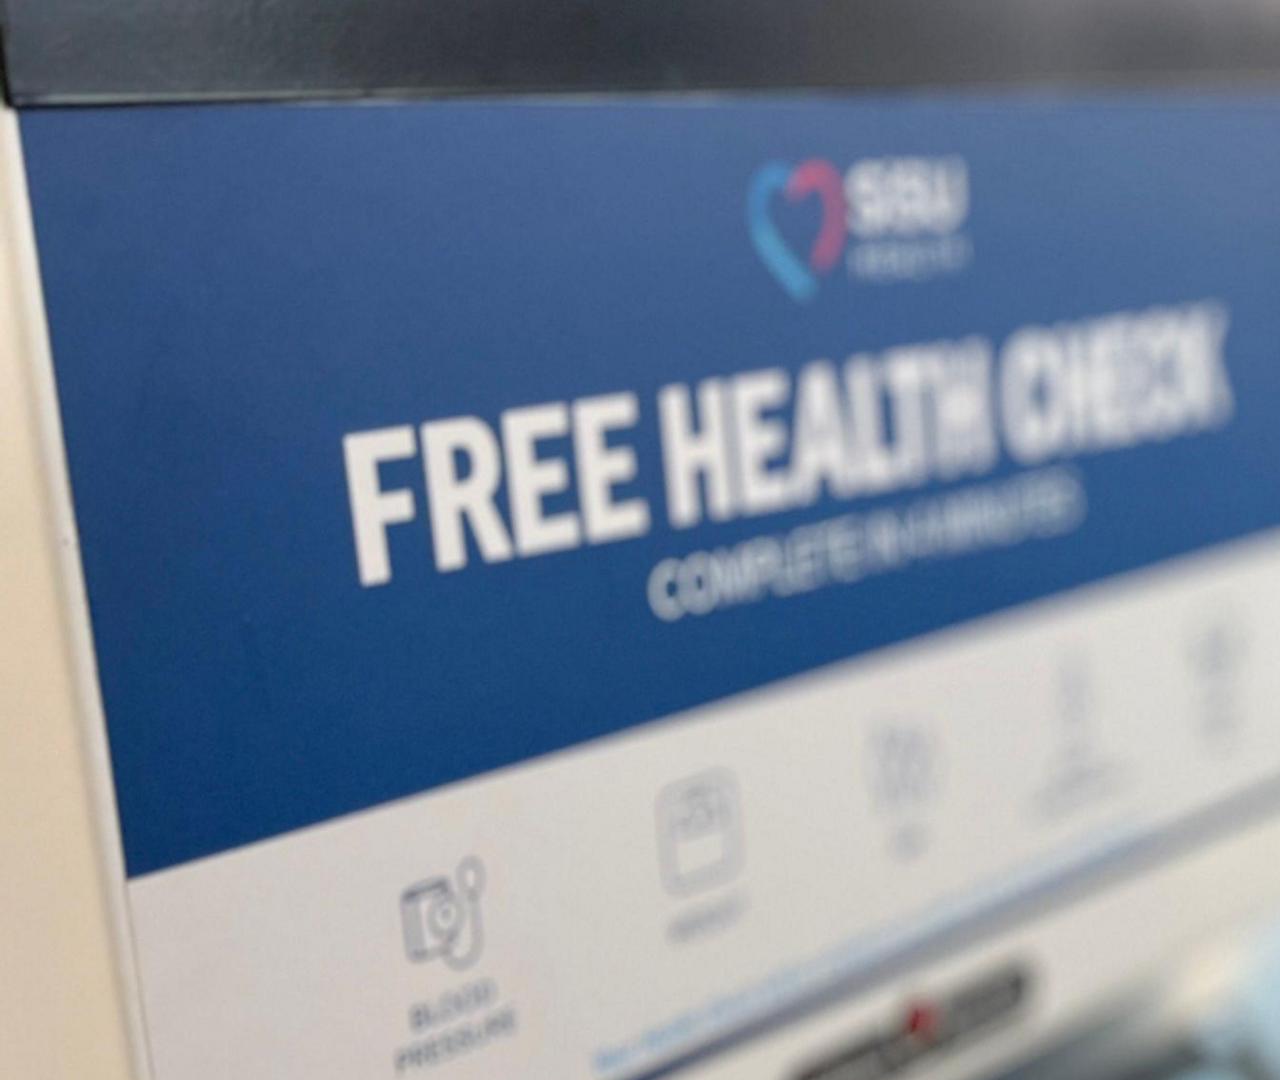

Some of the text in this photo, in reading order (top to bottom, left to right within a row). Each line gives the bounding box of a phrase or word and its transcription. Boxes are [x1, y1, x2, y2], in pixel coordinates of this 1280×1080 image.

[344, 301, 1234, 587] FREE HEALTH CHECK
[648, 513, 864, 621] COMPLETE
[393, 1008, 518, 1078] PRESSURE
[408, 978, 498, 1034] BLOOD
